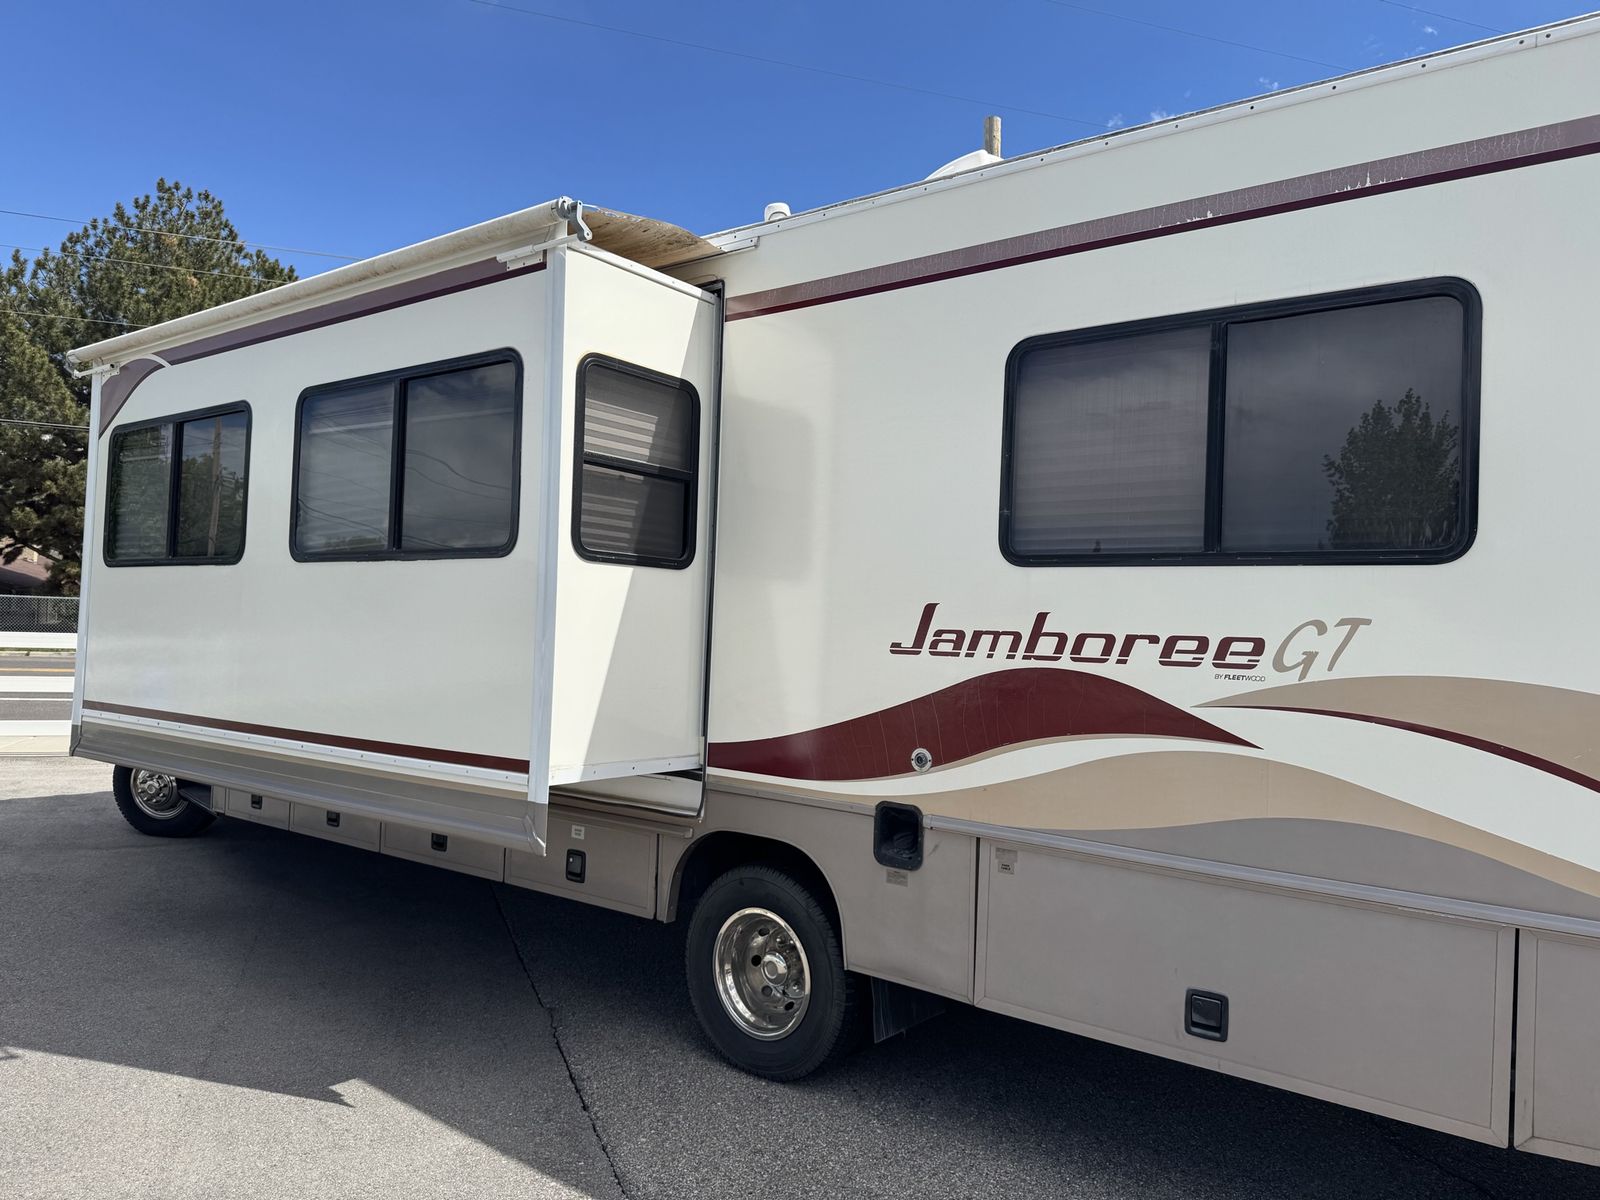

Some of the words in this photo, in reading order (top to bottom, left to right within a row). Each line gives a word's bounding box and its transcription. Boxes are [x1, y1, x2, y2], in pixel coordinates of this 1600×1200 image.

[889, 602, 1266, 670] Jamboree
[1272, 617, 1372, 682] GT
[1223, 674, 1266, 682] FLEETWOOD
